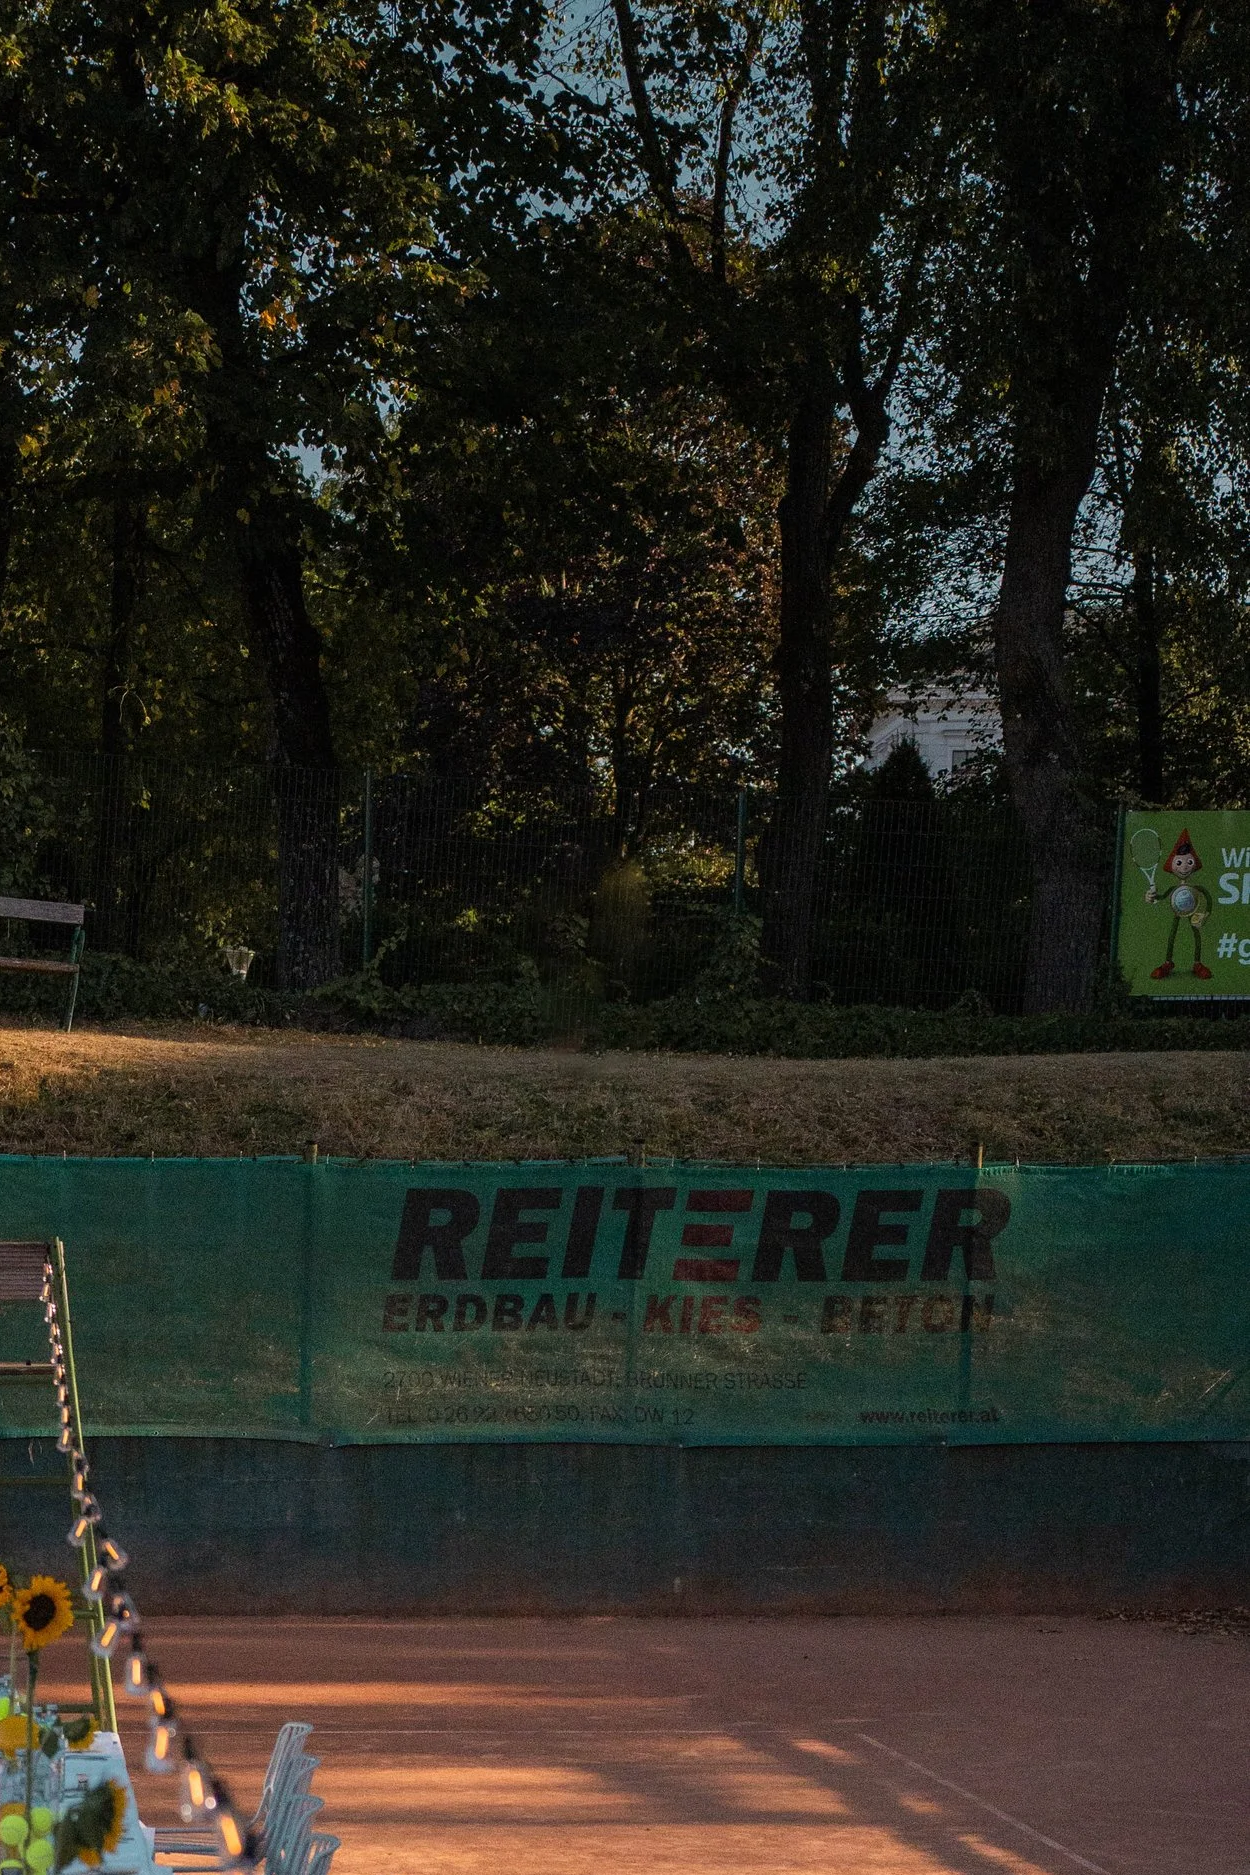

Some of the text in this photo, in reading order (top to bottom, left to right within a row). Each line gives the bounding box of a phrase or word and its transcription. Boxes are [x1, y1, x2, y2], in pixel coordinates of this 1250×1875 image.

[389, 1186, 1013, 1283] REITERER
[381, 1292, 598, 1334] ERDBAU
[643, 1294, 763, 1334] KIES
[820, 1293, 996, 1335] BETON
[383, 1371, 434, 1389] 2700
[625, 1371, 720, 1390] BRUNNER
[724, 1371, 808, 1391] STRASSE
[633, 1405, 664, 1423] DW
[671, 1407, 695, 1426] 12
[857, 1407, 1000, 1424] www.reiterer.at
